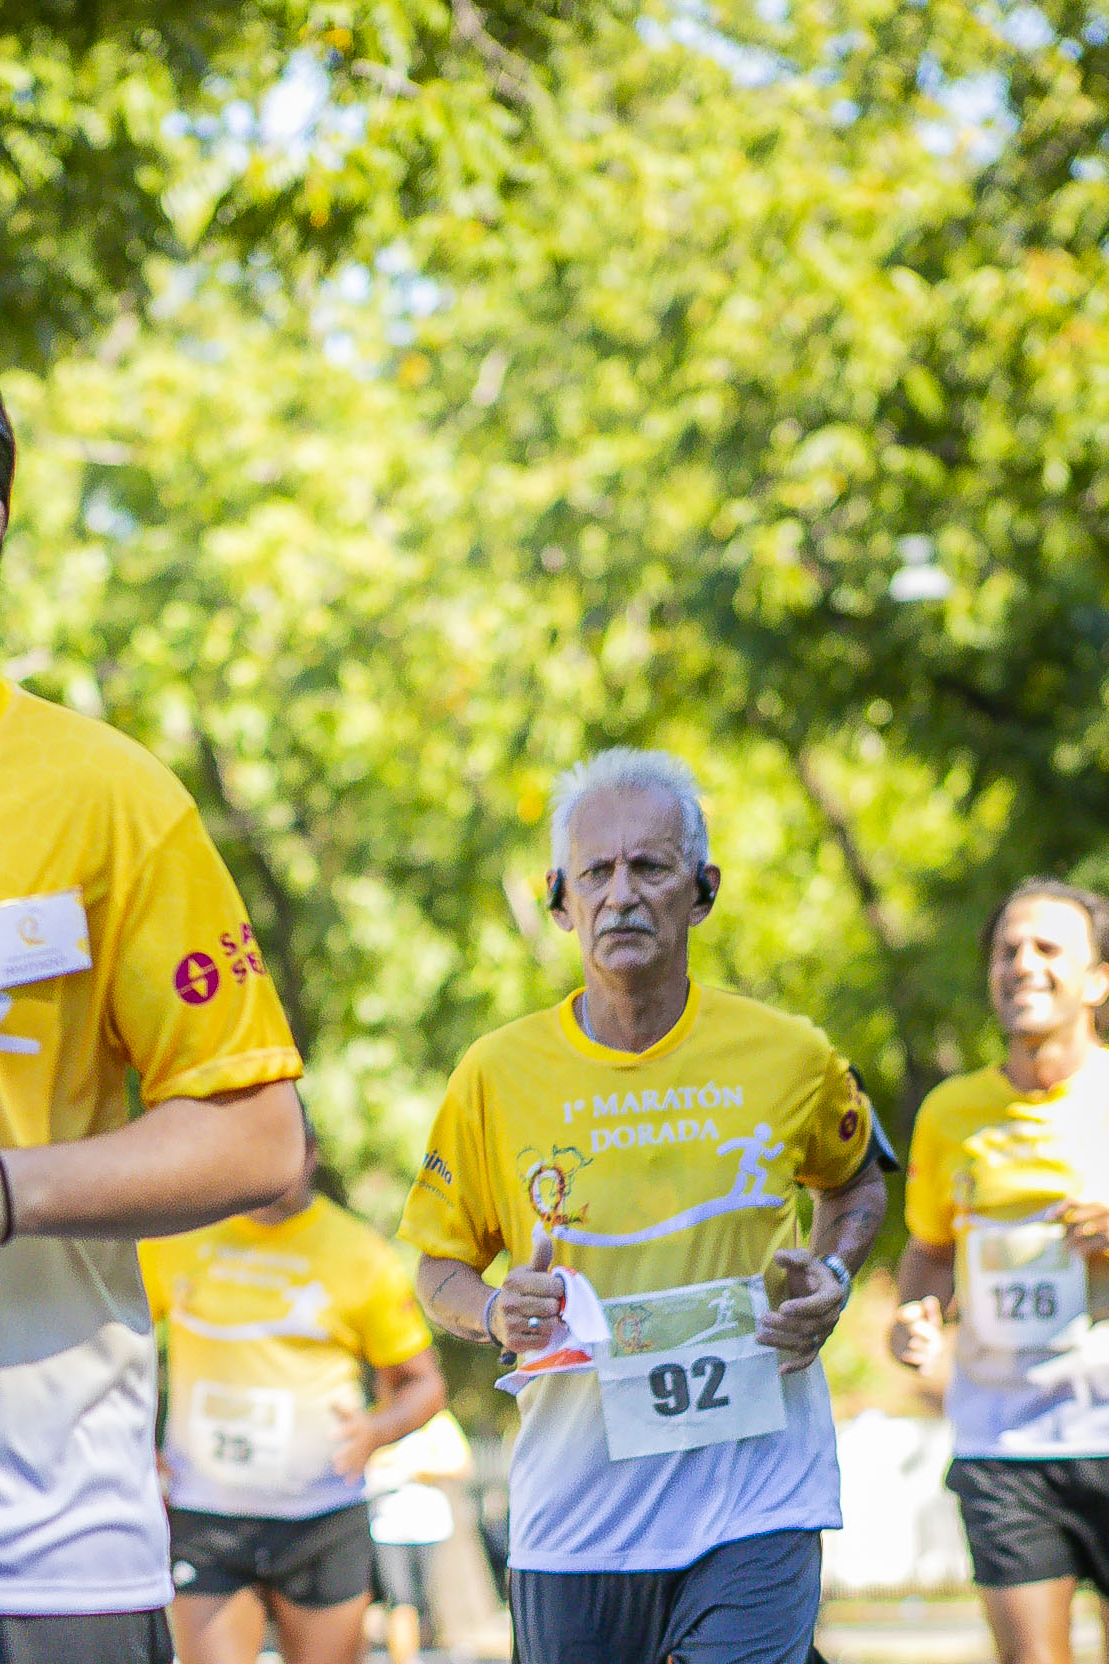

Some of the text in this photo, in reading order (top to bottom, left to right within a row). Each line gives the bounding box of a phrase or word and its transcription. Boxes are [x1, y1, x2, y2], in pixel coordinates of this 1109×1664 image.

[592, 1080, 744, 1119] MARATÓN
[590, 1117, 720, 1154] DORADA
[992, 1281, 1057, 1321] 126
[648, 1355, 731, 1417] 92
